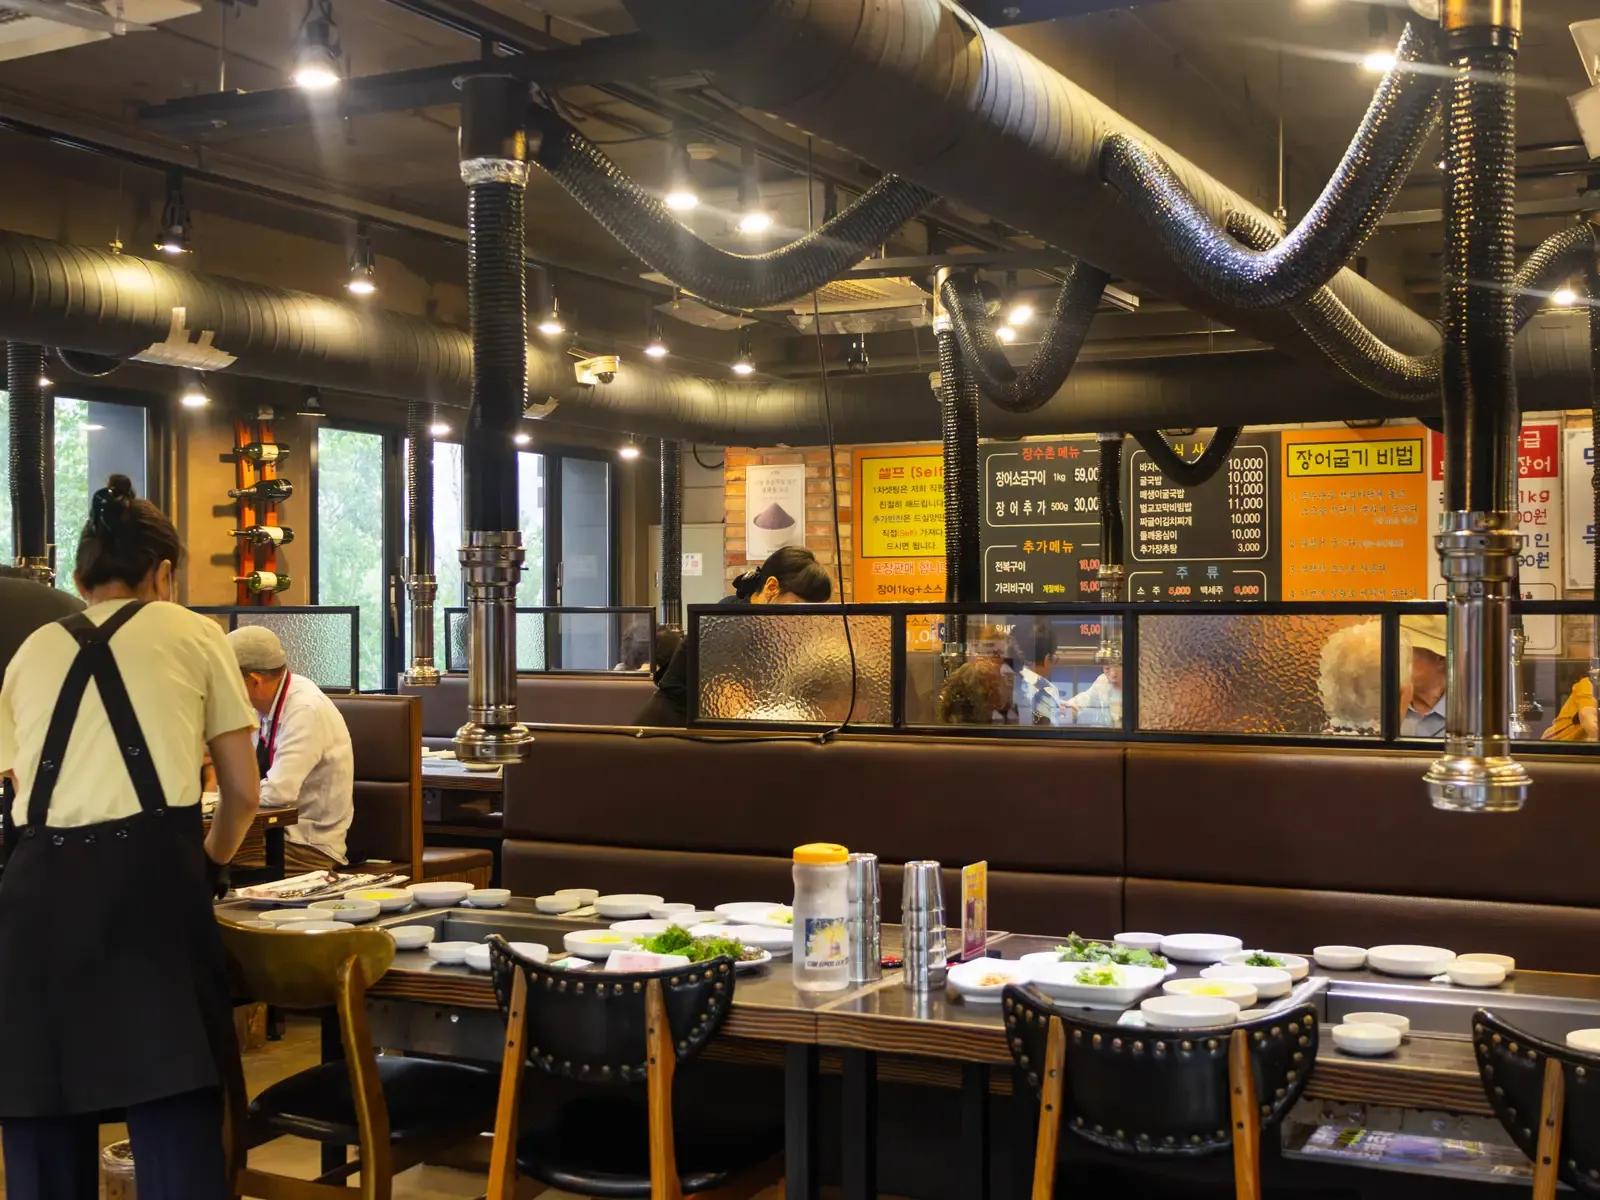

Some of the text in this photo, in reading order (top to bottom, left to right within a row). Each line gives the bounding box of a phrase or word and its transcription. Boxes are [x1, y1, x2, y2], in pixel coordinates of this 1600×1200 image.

[1057, 446, 1080, 459] 메뉴
[1296, 445, 1413, 470] 장어굽기 비법
[1228, 458, 1263, 470] 10,000
[879, 467, 904, 479] 셀프
[995, 470, 1046, 487] 장어소금구이
[1053, 473, 1066, 482] 1kg
[1228, 470, 1263, 483] 10,000
[911, 484, 926, 492] 저희
[1228, 483, 1263, 496] 11,000
[1051, 502, 1068, 512] 500g
[1228, 498, 1263, 510] 11,000
[1231, 513, 1260, 525] 10,000
[1231, 528, 1261, 540] 10,000
[1237, 542, 1260, 552] 3,000
[872, 561, 914, 575] 포장판매
[995, 560, 1026, 572] 전복구이
[995, 582, 1034, 594] 가리비구이
